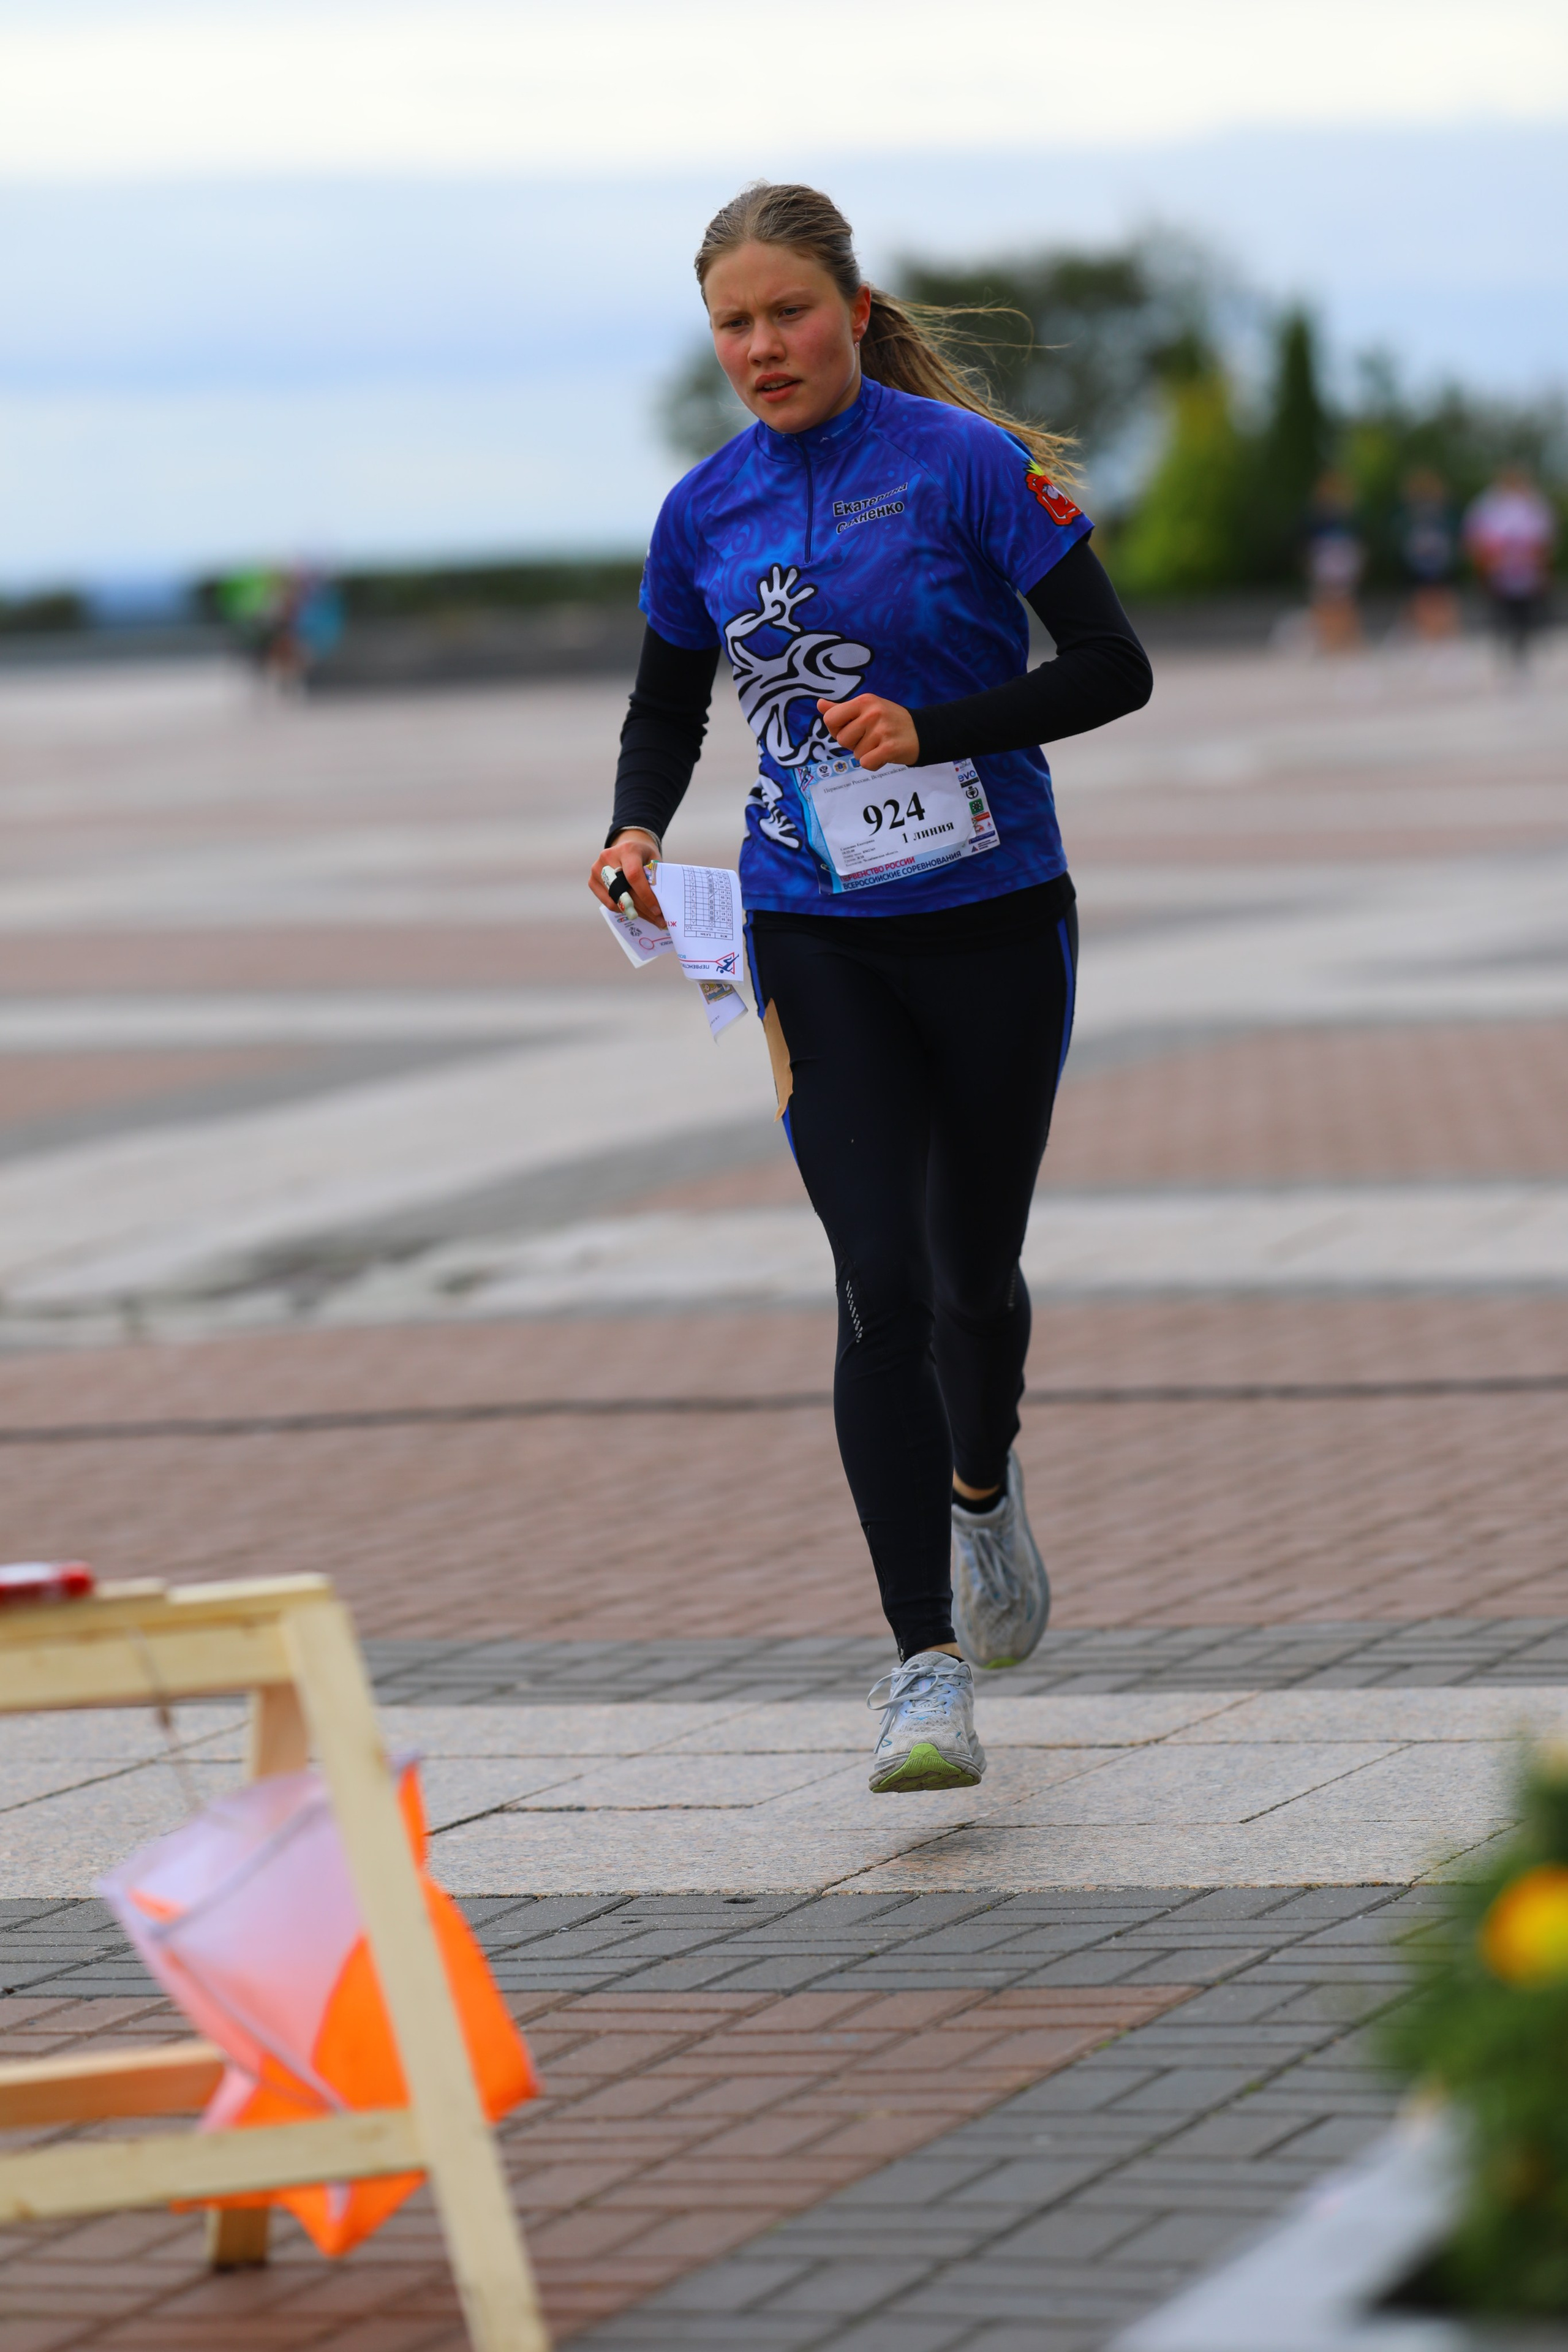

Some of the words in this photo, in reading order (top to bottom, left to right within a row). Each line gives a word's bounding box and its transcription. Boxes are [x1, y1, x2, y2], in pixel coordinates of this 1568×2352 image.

[833, 483, 908, 517] Екатерина
[958, 770, 976, 782] evo
[863, 791, 925, 836] 924
[902, 832, 908, 843] 1
[913, 822, 954, 842] ЛИНИЯ
[840, 865, 884, 881] ПЕРВЕНСТВО
[885, 856, 916, 870] РОССИИ
[902, 850, 962, 875] СОРЕВНОВАНИЯ
